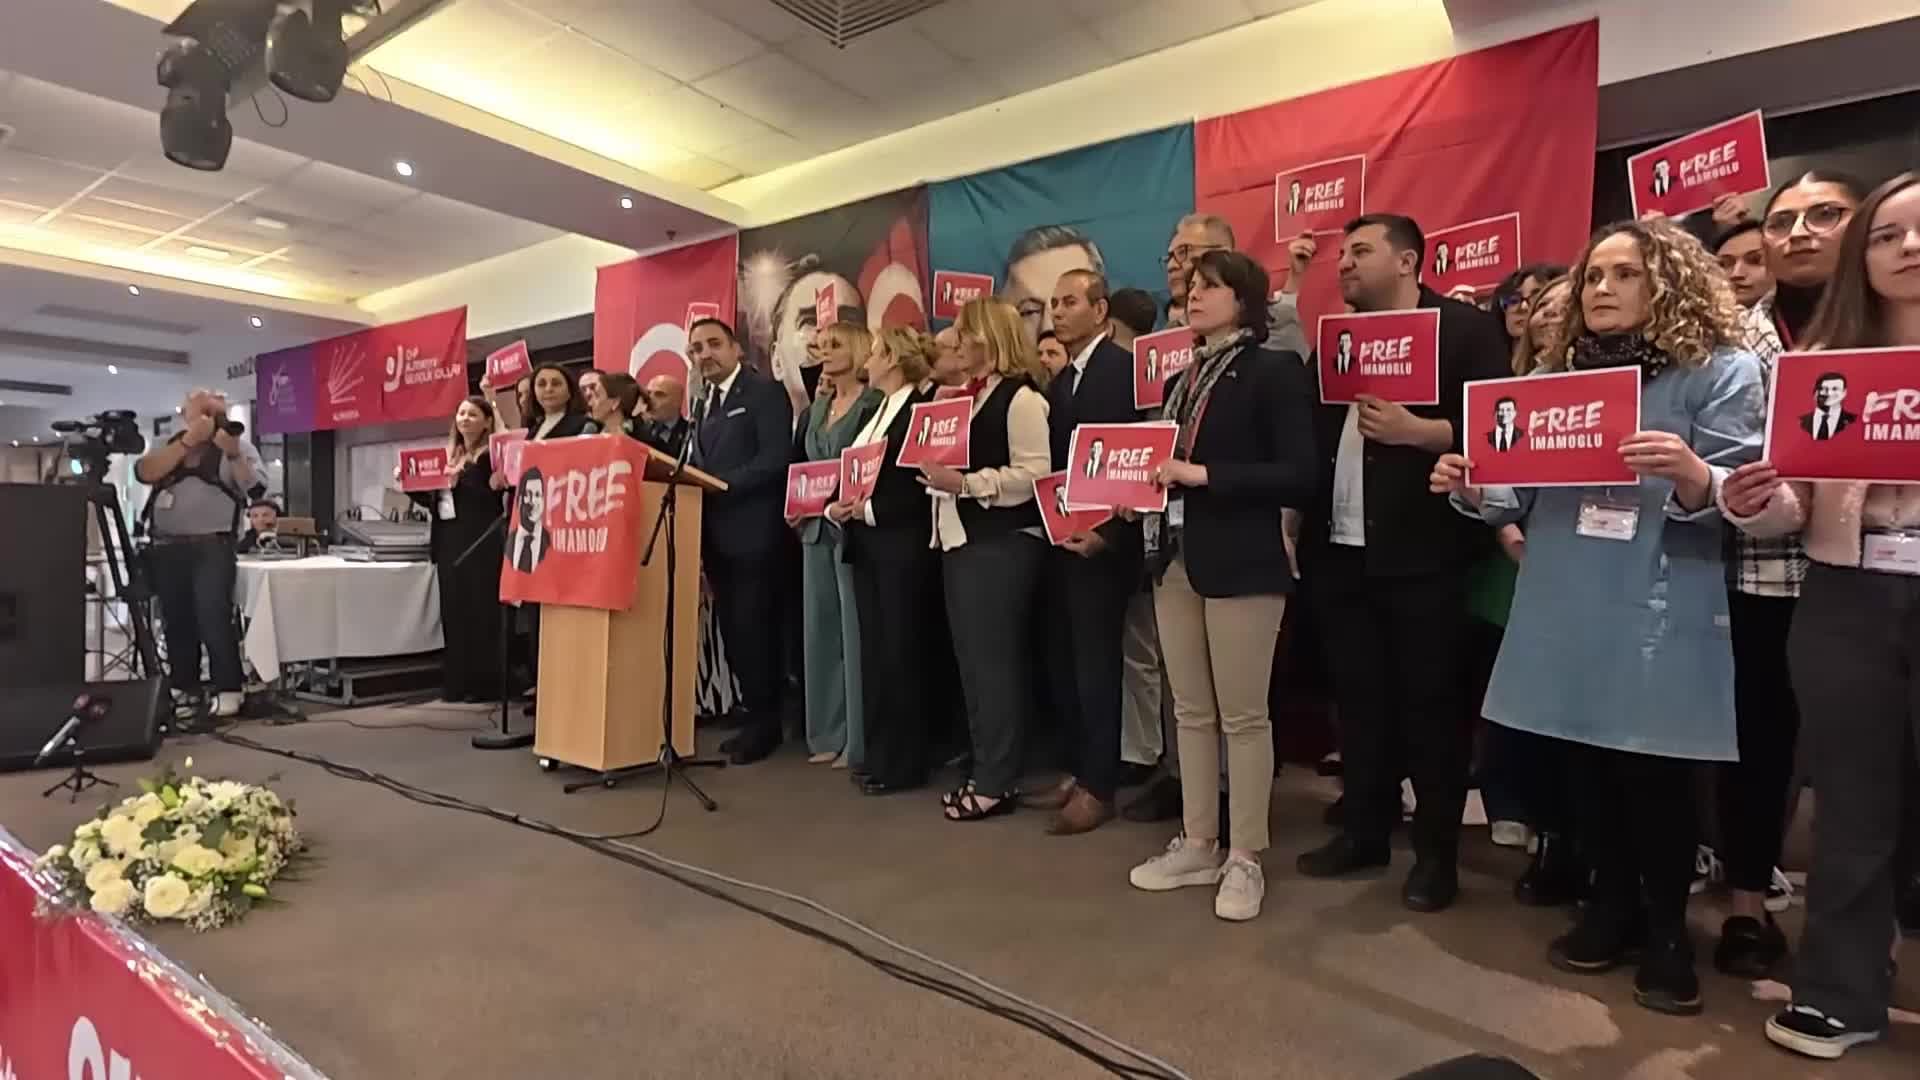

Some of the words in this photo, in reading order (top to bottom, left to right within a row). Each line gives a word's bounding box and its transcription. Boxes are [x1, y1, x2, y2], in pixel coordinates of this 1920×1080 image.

[1680, 140, 1737, 177] FREE
[1304, 177, 1344, 202] FREE
[1455, 235, 1499, 262] FREE
[1359, 336, 1413, 363] FREE
[1528, 400, 1604, 436] FREE
[1862, 388, 1920, 423] FR
[932, 416, 959, 435] FREE
[1864, 423, 1920, 440] IMAM
[1530, 433, 1602, 450] IMAMOGLU
[1107, 447, 1153, 470] FREE
[546, 460, 632, 527] FREE
